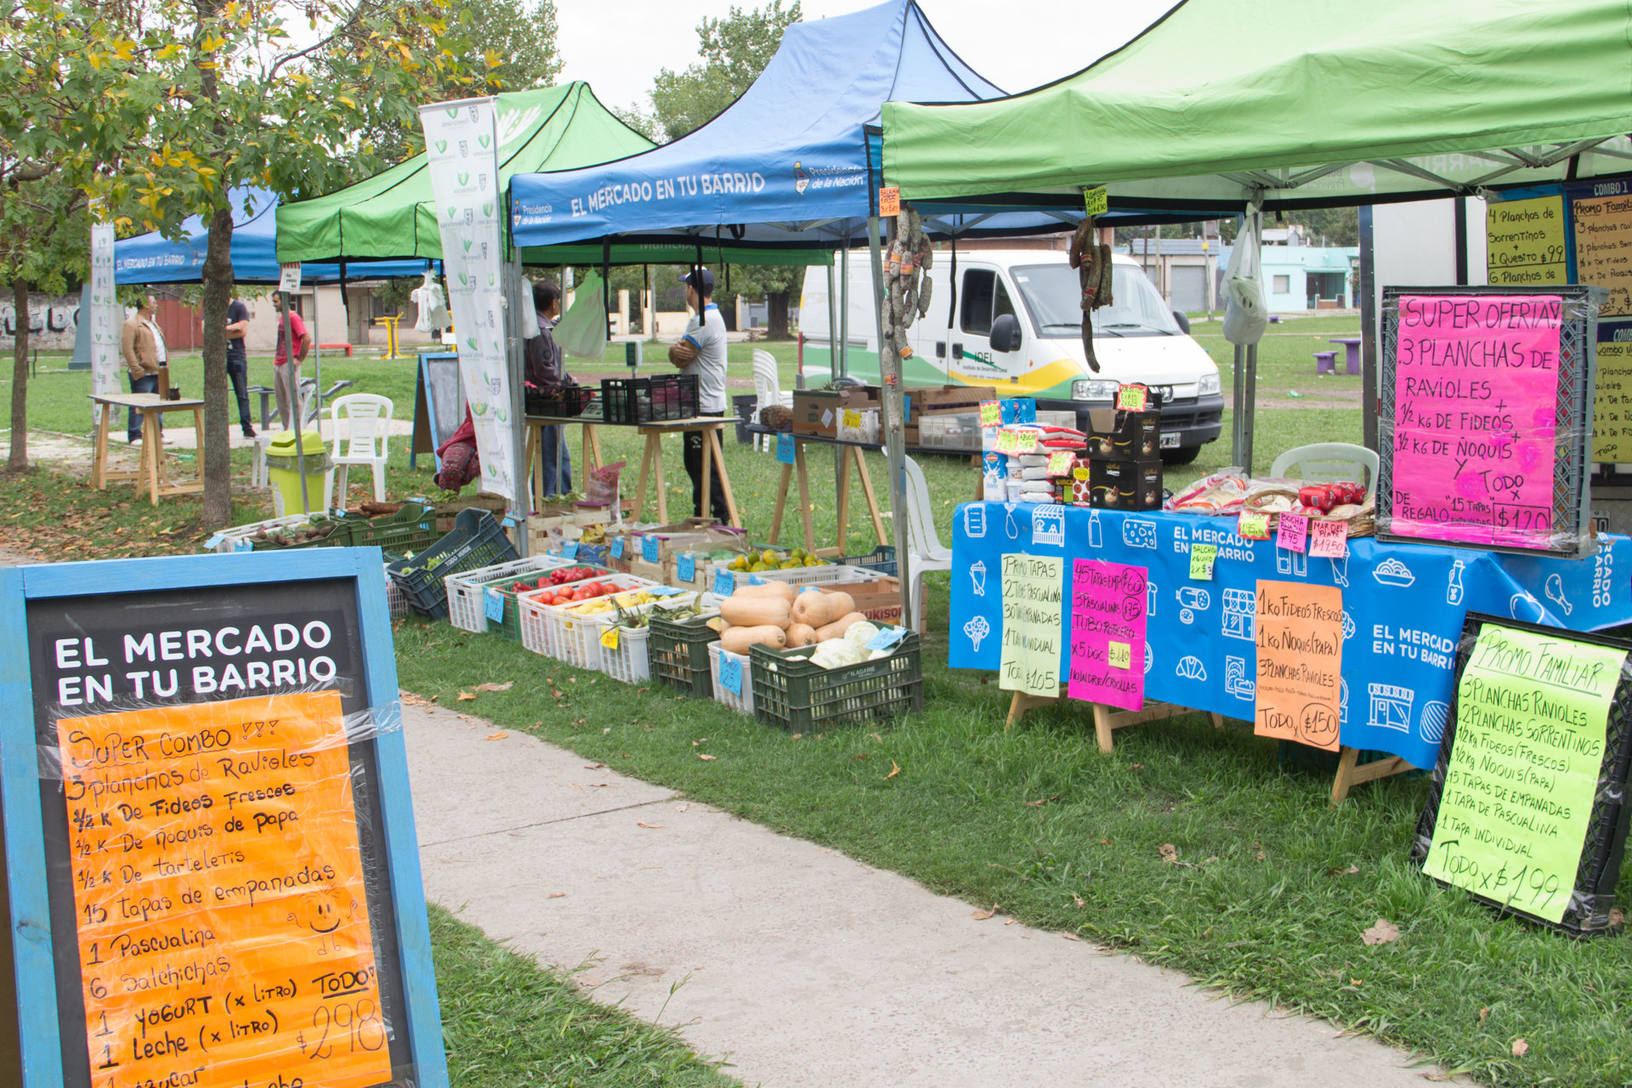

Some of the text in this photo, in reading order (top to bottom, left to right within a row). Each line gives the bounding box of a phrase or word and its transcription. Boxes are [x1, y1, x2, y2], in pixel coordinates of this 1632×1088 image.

[812, 176, 863, 189] de la Nación
[1594, 182, 1628, 196] COMBO 1
[571, 172, 765, 217] EL MERCADO EN TU BARRIO
[1489, 208, 1496, 223] 4
[1543, 208, 1554, 219] de
[1578, 224, 1585, 234] 3
[1490, 254, 1496, 264] 1
[1546, 269, 1555, 279] de
[1406, 299, 1480, 328] SUPER
[975, 352, 994, 364] IDEL
[1418, 339, 1524, 367] PLANCHAS
[1530, 350, 1553, 369] DE
[1436, 413, 1452, 429] DE
[1460, 413, 1513, 432] FIDEOS
[1432, 440, 1448, 455] DE
[1396, 491, 1411, 505] DE
[1402, 507, 1449, 522] REGALO
[1499, 507, 1549, 535] $120
[1174, 526, 1254, 548] EL MERCADO
[1174, 541, 1254, 562] EN ARRIO
[1373, 624, 1394, 639] EL
[56, 621, 331, 669] EL MERCADO
[1373, 641, 1456, 670] EN TU BARRI
[1478, 629, 1604, 690] PROMO FAMILIAR
[58, 655, 336, 706] EN TU BARRIO
[1472, 678, 1529, 712] PLANCHAS
[1532, 691, 1587, 726] RAVIOLES
[1305, 710, 1336, 733] $150
[1471, 705, 1522, 737] PLANCHAS
[160, 729, 230, 756] COMBO
[189, 760, 209, 780] de
[118, 804, 144, 822] De
[150, 794, 213, 817] Fideos
[224, 782, 296, 810] Frescos
[1455, 792, 1475, 813] TAPA
[1479, 801, 1490, 816] DE
[1495, 785, 1508, 800] DE
[120, 834, 144, 852] De
[224, 817, 244, 834] de
[120, 865, 142, 884] De
[1493, 861, 1559, 910] $199
[83, 904, 107, 926] 15
[182, 886, 203, 904] de
[214, 864, 336, 900] empanadas
[85, 927, 215, 965] 1 Pascualina
[90, 977, 107, 1000] 6
[98, 1012, 115, 1036] 1
[98, 1032, 189, 1069] 1 Leche
